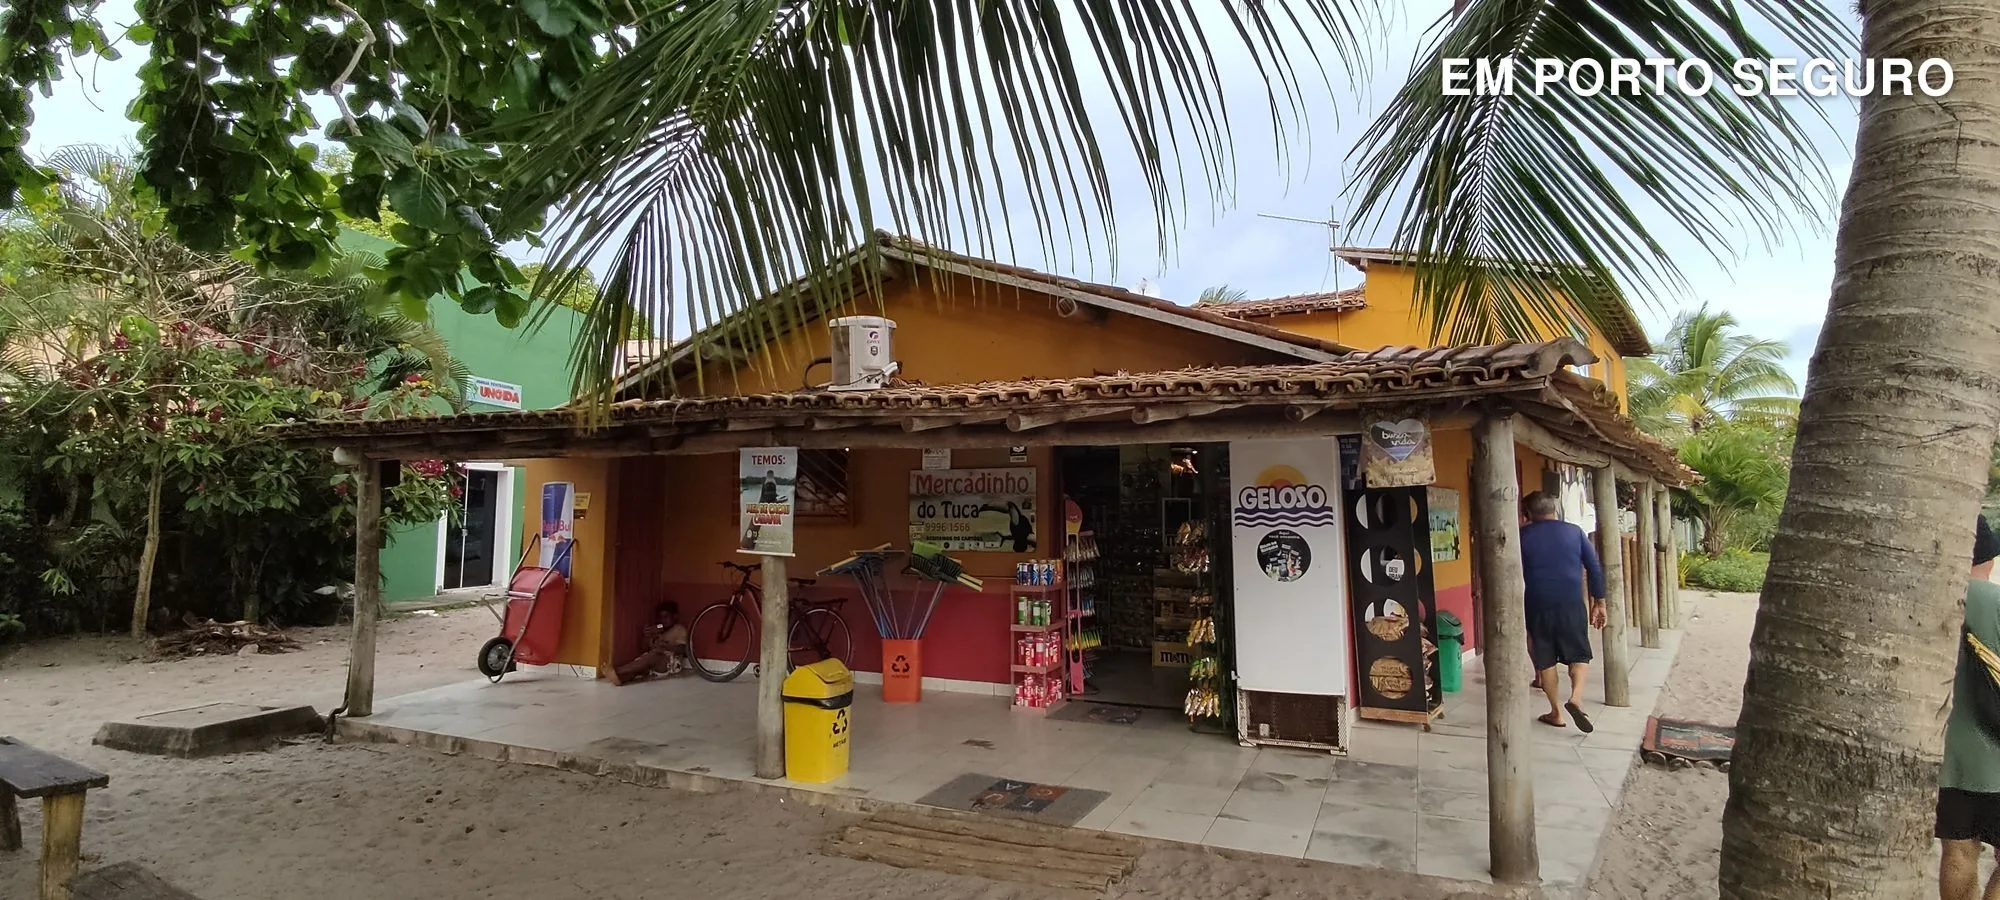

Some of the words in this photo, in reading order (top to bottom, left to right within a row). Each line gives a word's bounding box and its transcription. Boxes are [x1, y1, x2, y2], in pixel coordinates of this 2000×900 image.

[751, 454, 786, 466] TEMOS:
[916, 471, 1029, 496] Mercadinho
[1239, 485, 1327, 511] GELOSO
[917, 501, 936, 519] do
[941, 500, 979, 519] Tuca
